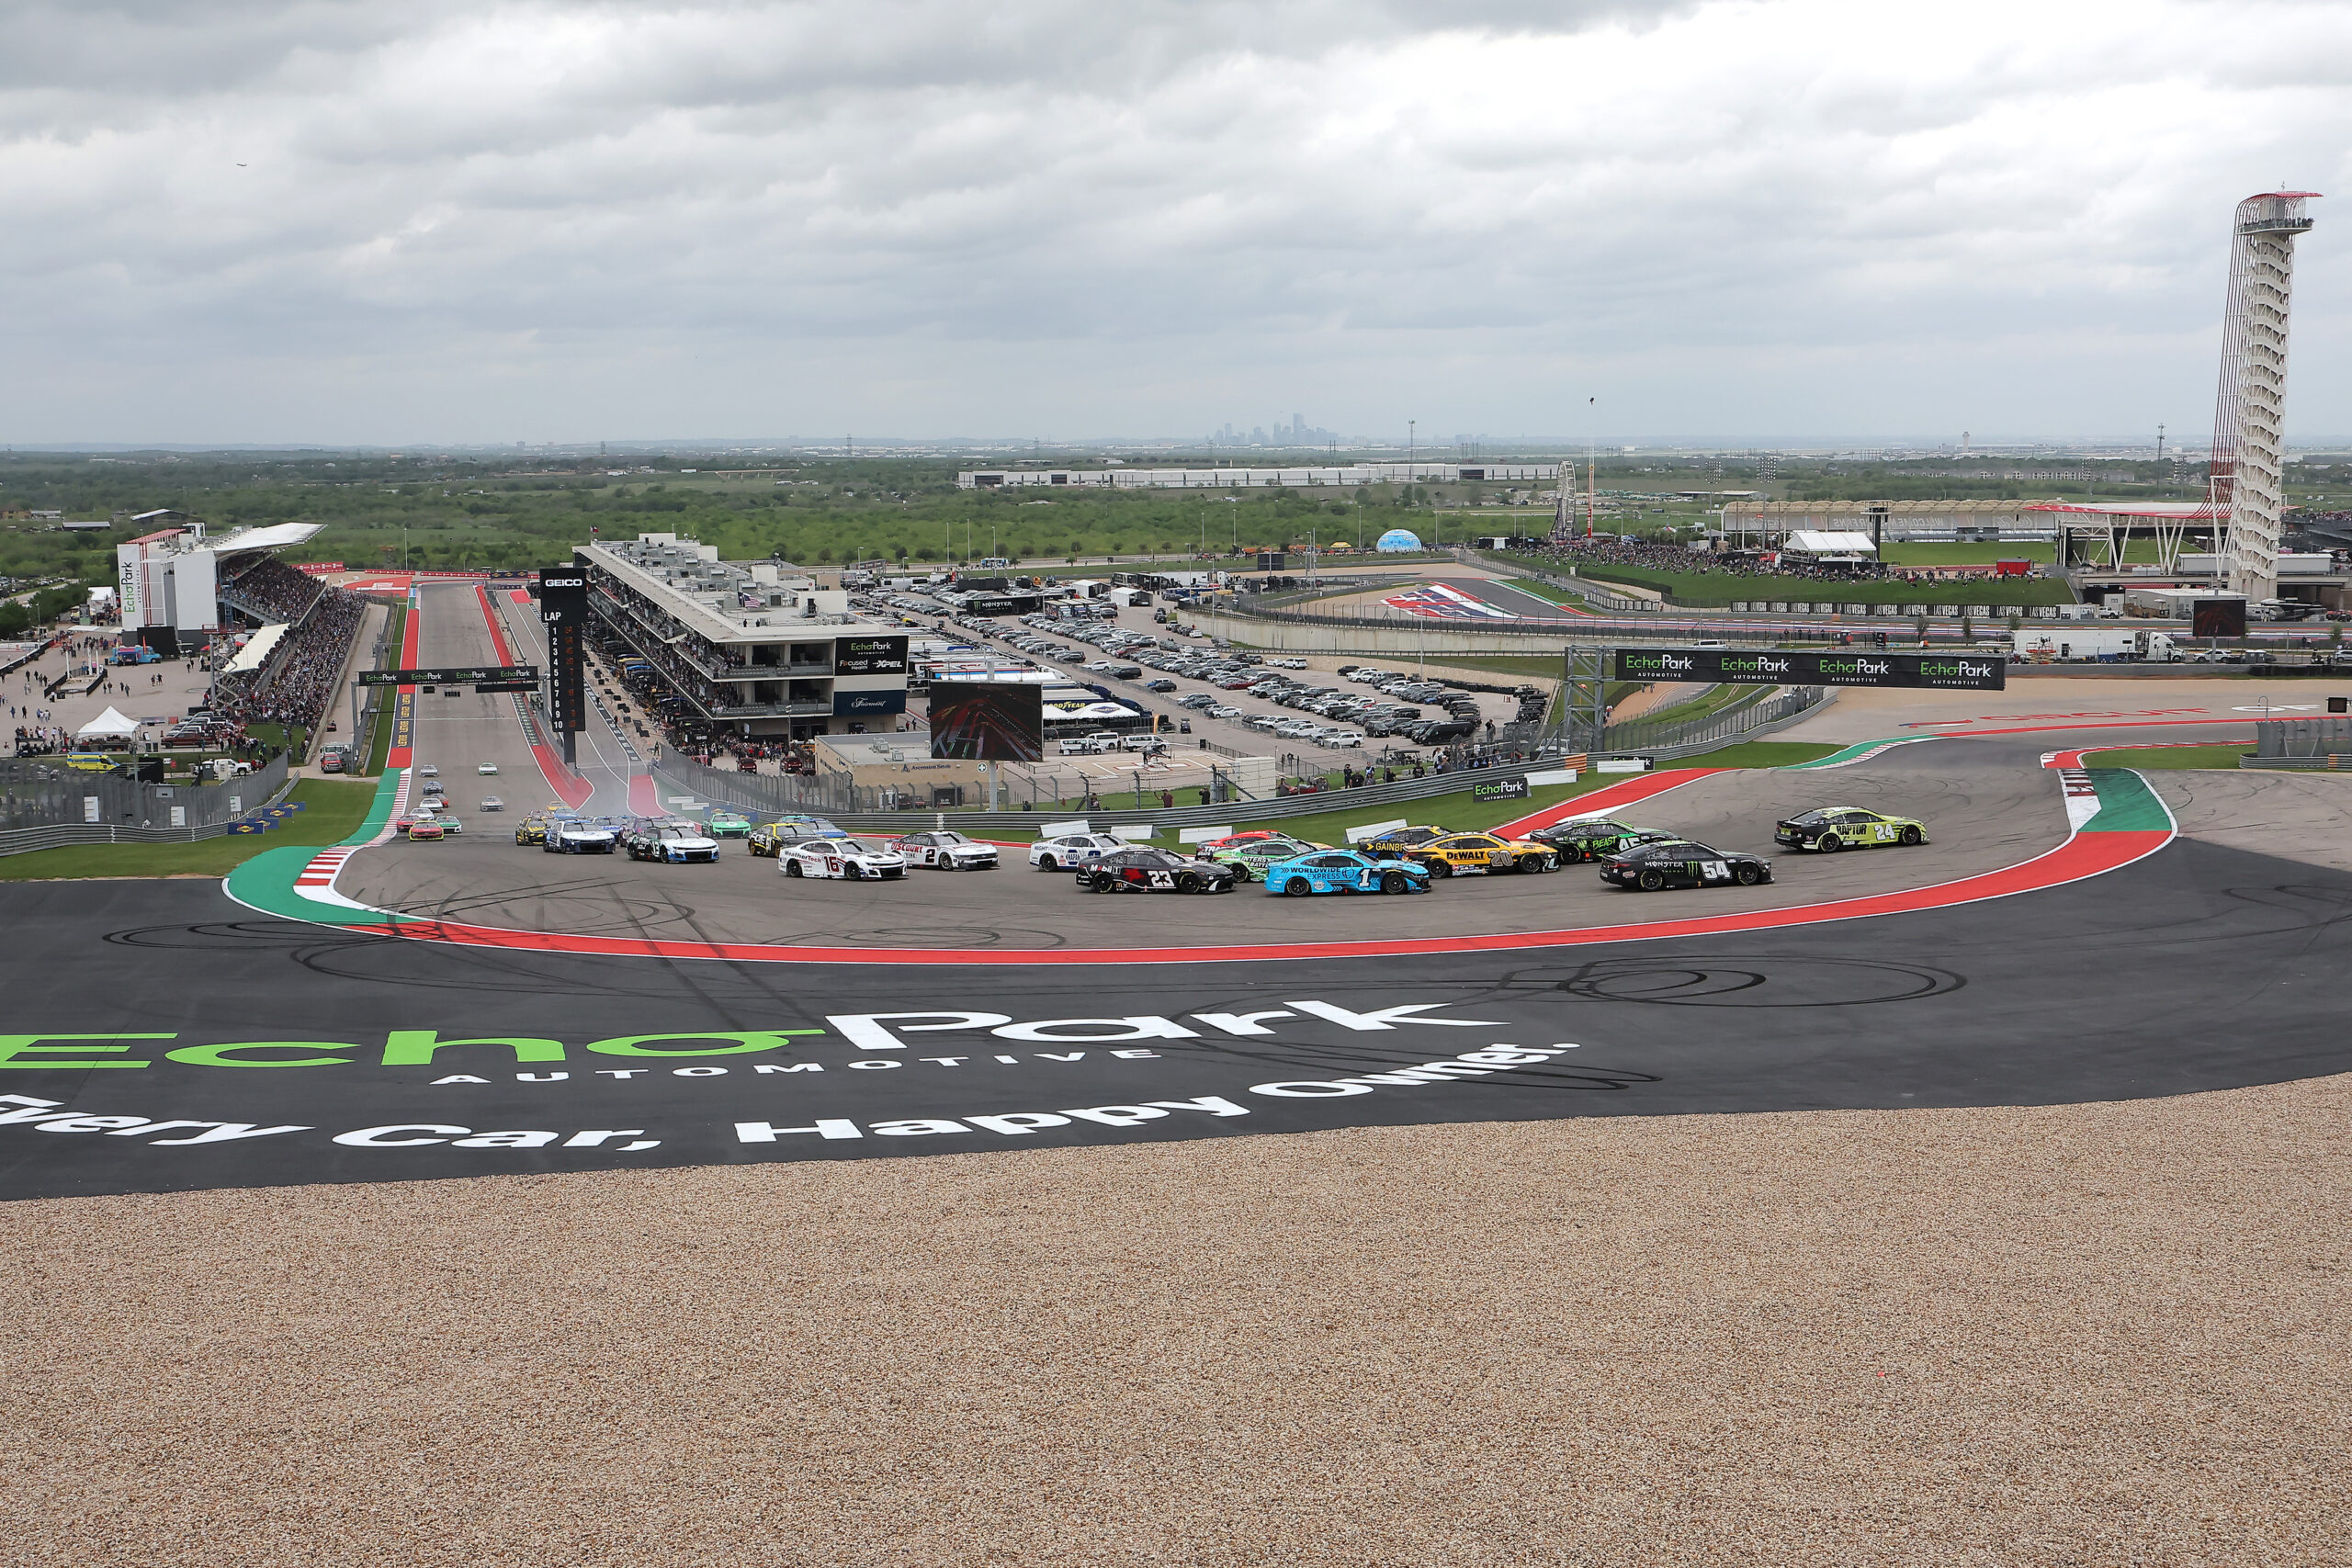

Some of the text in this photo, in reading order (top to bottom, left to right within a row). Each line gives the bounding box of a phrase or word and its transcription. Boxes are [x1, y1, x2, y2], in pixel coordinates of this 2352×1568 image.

[120, 561, 135, 613] EchoPark
[545, 579, 583, 587] GEICO
[544, 613, 561, 621] LAP
[552, 637, 558, 646] 2
[851, 641, 891, 651] EchoPark
[553, 648, 559, 656] 3
[876, 660, 903, 668] XPEL
[1625, 654, 1693, 670] EchoPark
[1721, 656, 1789, 672] EchoPark
[1819, 658, 1889, 674] EchoPark
[1919, 660, 1992, 678] EchoPark
[500, 670, 530, 678] EchoPark
[554, 669, 559, 677] 5
[554, 679, 560, 687] 6
[555, 700, 560, 708] 8
[555, 710, 560, 718] 9
[1978, 704, 2321, 721] CIRCUIT OF
[553, 720, 563, 728] 10
[1475, 781, 1523, 795] EchoPark
[1837, 824, 1867, 836] RAPTOR
[1874, 823, 1895, 840] 24
[891, 842, 922, 853] DISCOUNT
[1592, 835, 1618, 850] BEAST
[785, 851, 822, 863] WeatherTech
[925, 849, 936, 863] 2
[1066, 853, 1080, 862] NAPA
[1487, 850, 1514, 867] 20
[824, 855, 840, 872] 16
[1090, 864, 1113, 874] Mobil
[1701, 861, 1731, 880] 54
[1148, 870, 1175, 887] 23
[1359, 868, 1371, 888] 1
[0, 999, 1512, 1070] EchoPark
[428, 1049, 1162, 1085] AUTOMOTIVE
[332, 1122, 662, 1152] Car,
[734, 1096, 1251, 1145] Happy
[1249, 1043, 1581, 1098] Owner.
